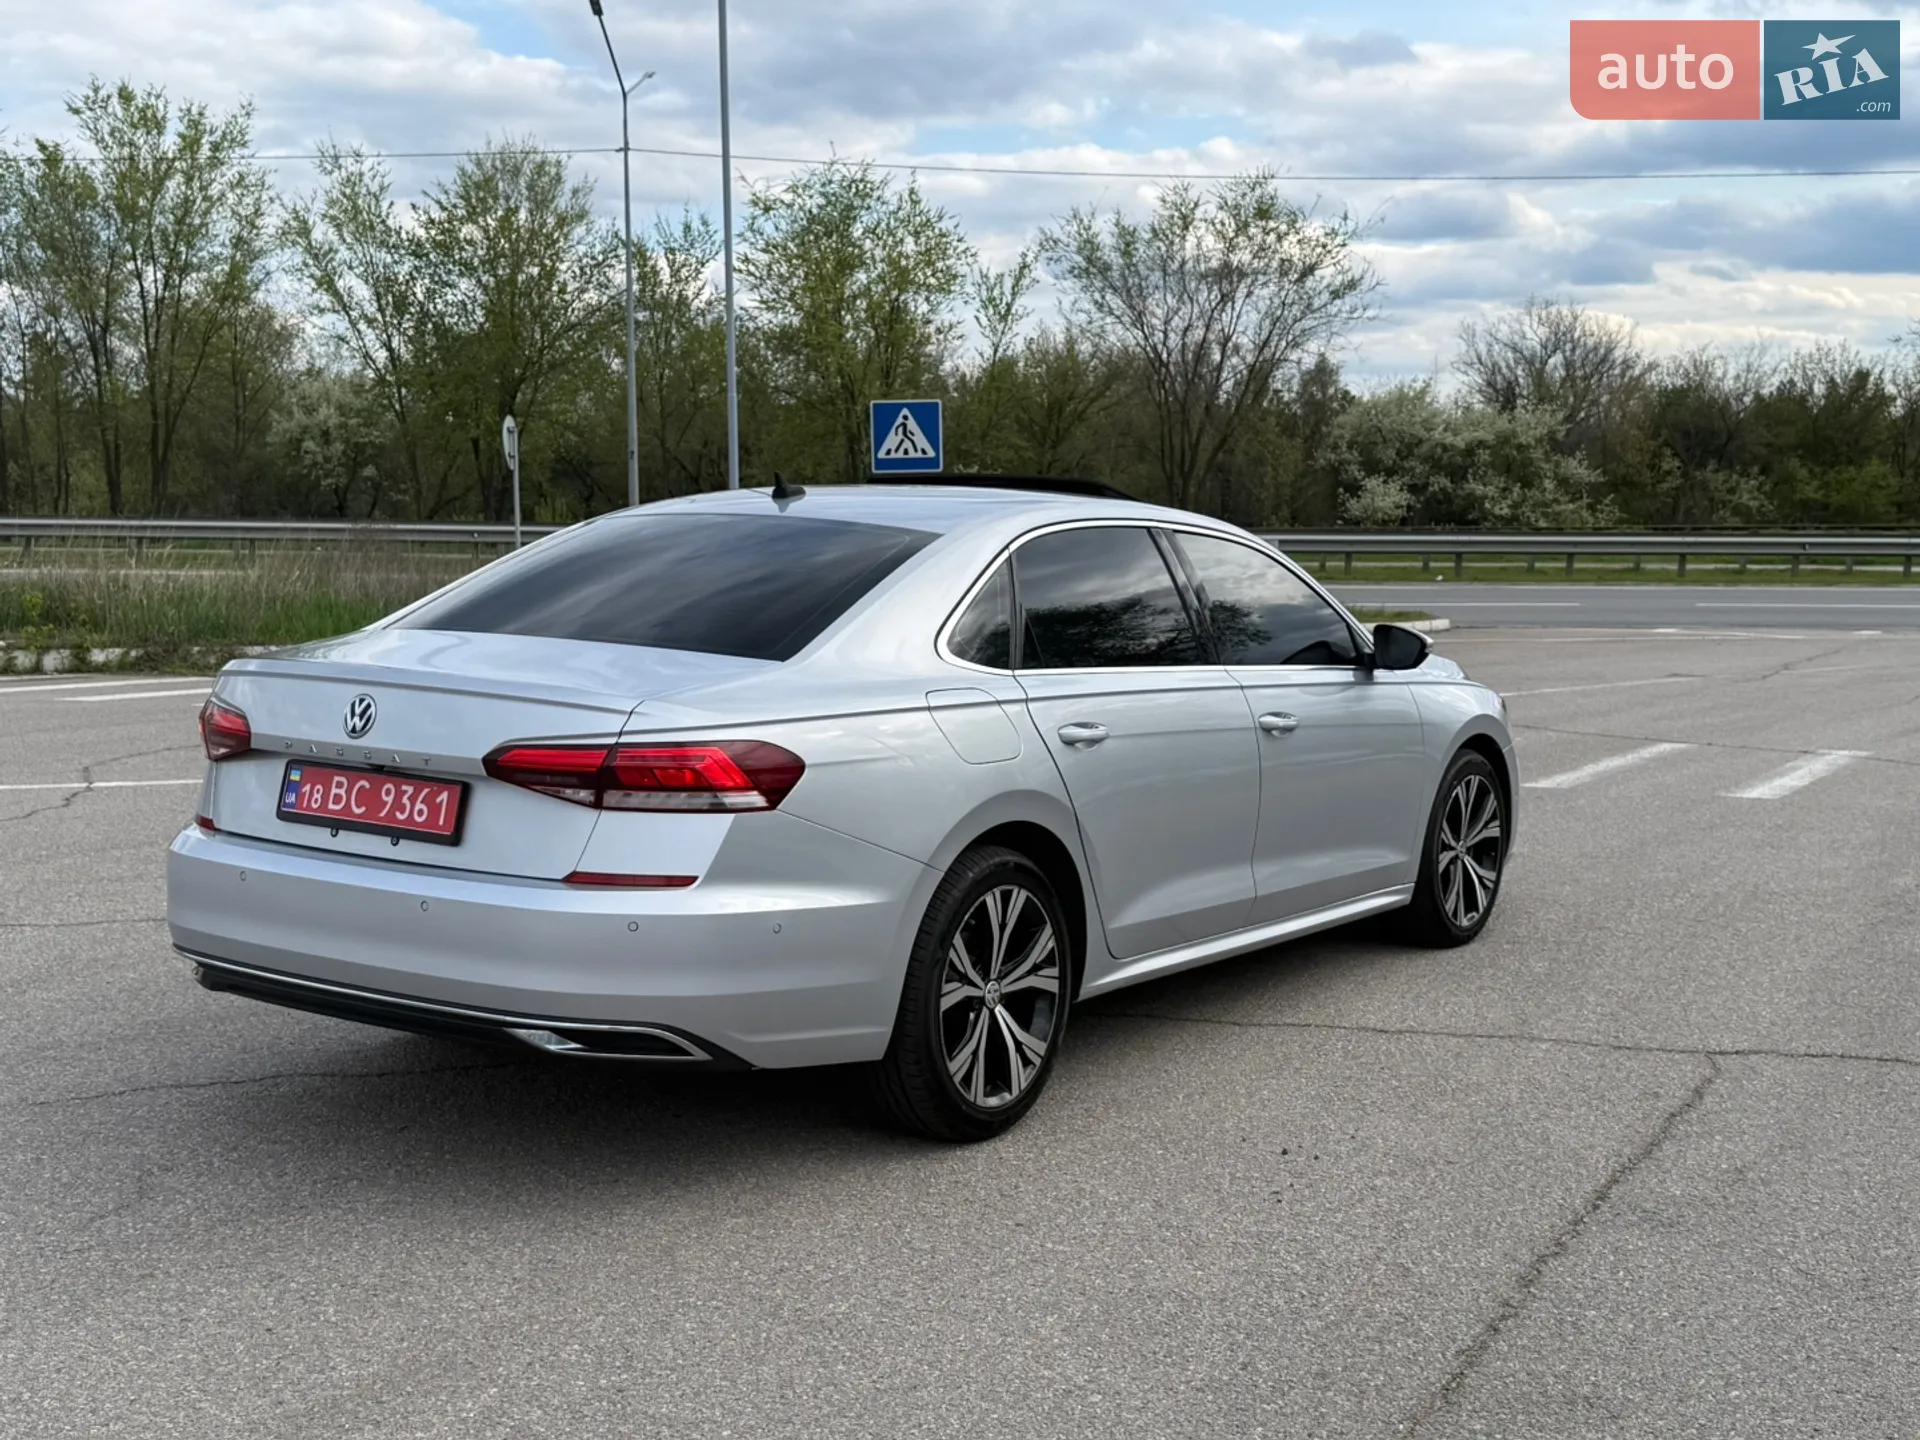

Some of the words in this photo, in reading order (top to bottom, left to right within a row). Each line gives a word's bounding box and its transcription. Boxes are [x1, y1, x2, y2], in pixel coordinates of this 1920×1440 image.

[284, 740, 432, 767] PASSAT
[285, 791, 297, 805] UA
[301, 782, 324, 810] 18
[327, 775, 371, 815] BC
[378, 783, 450, 827] 9361
